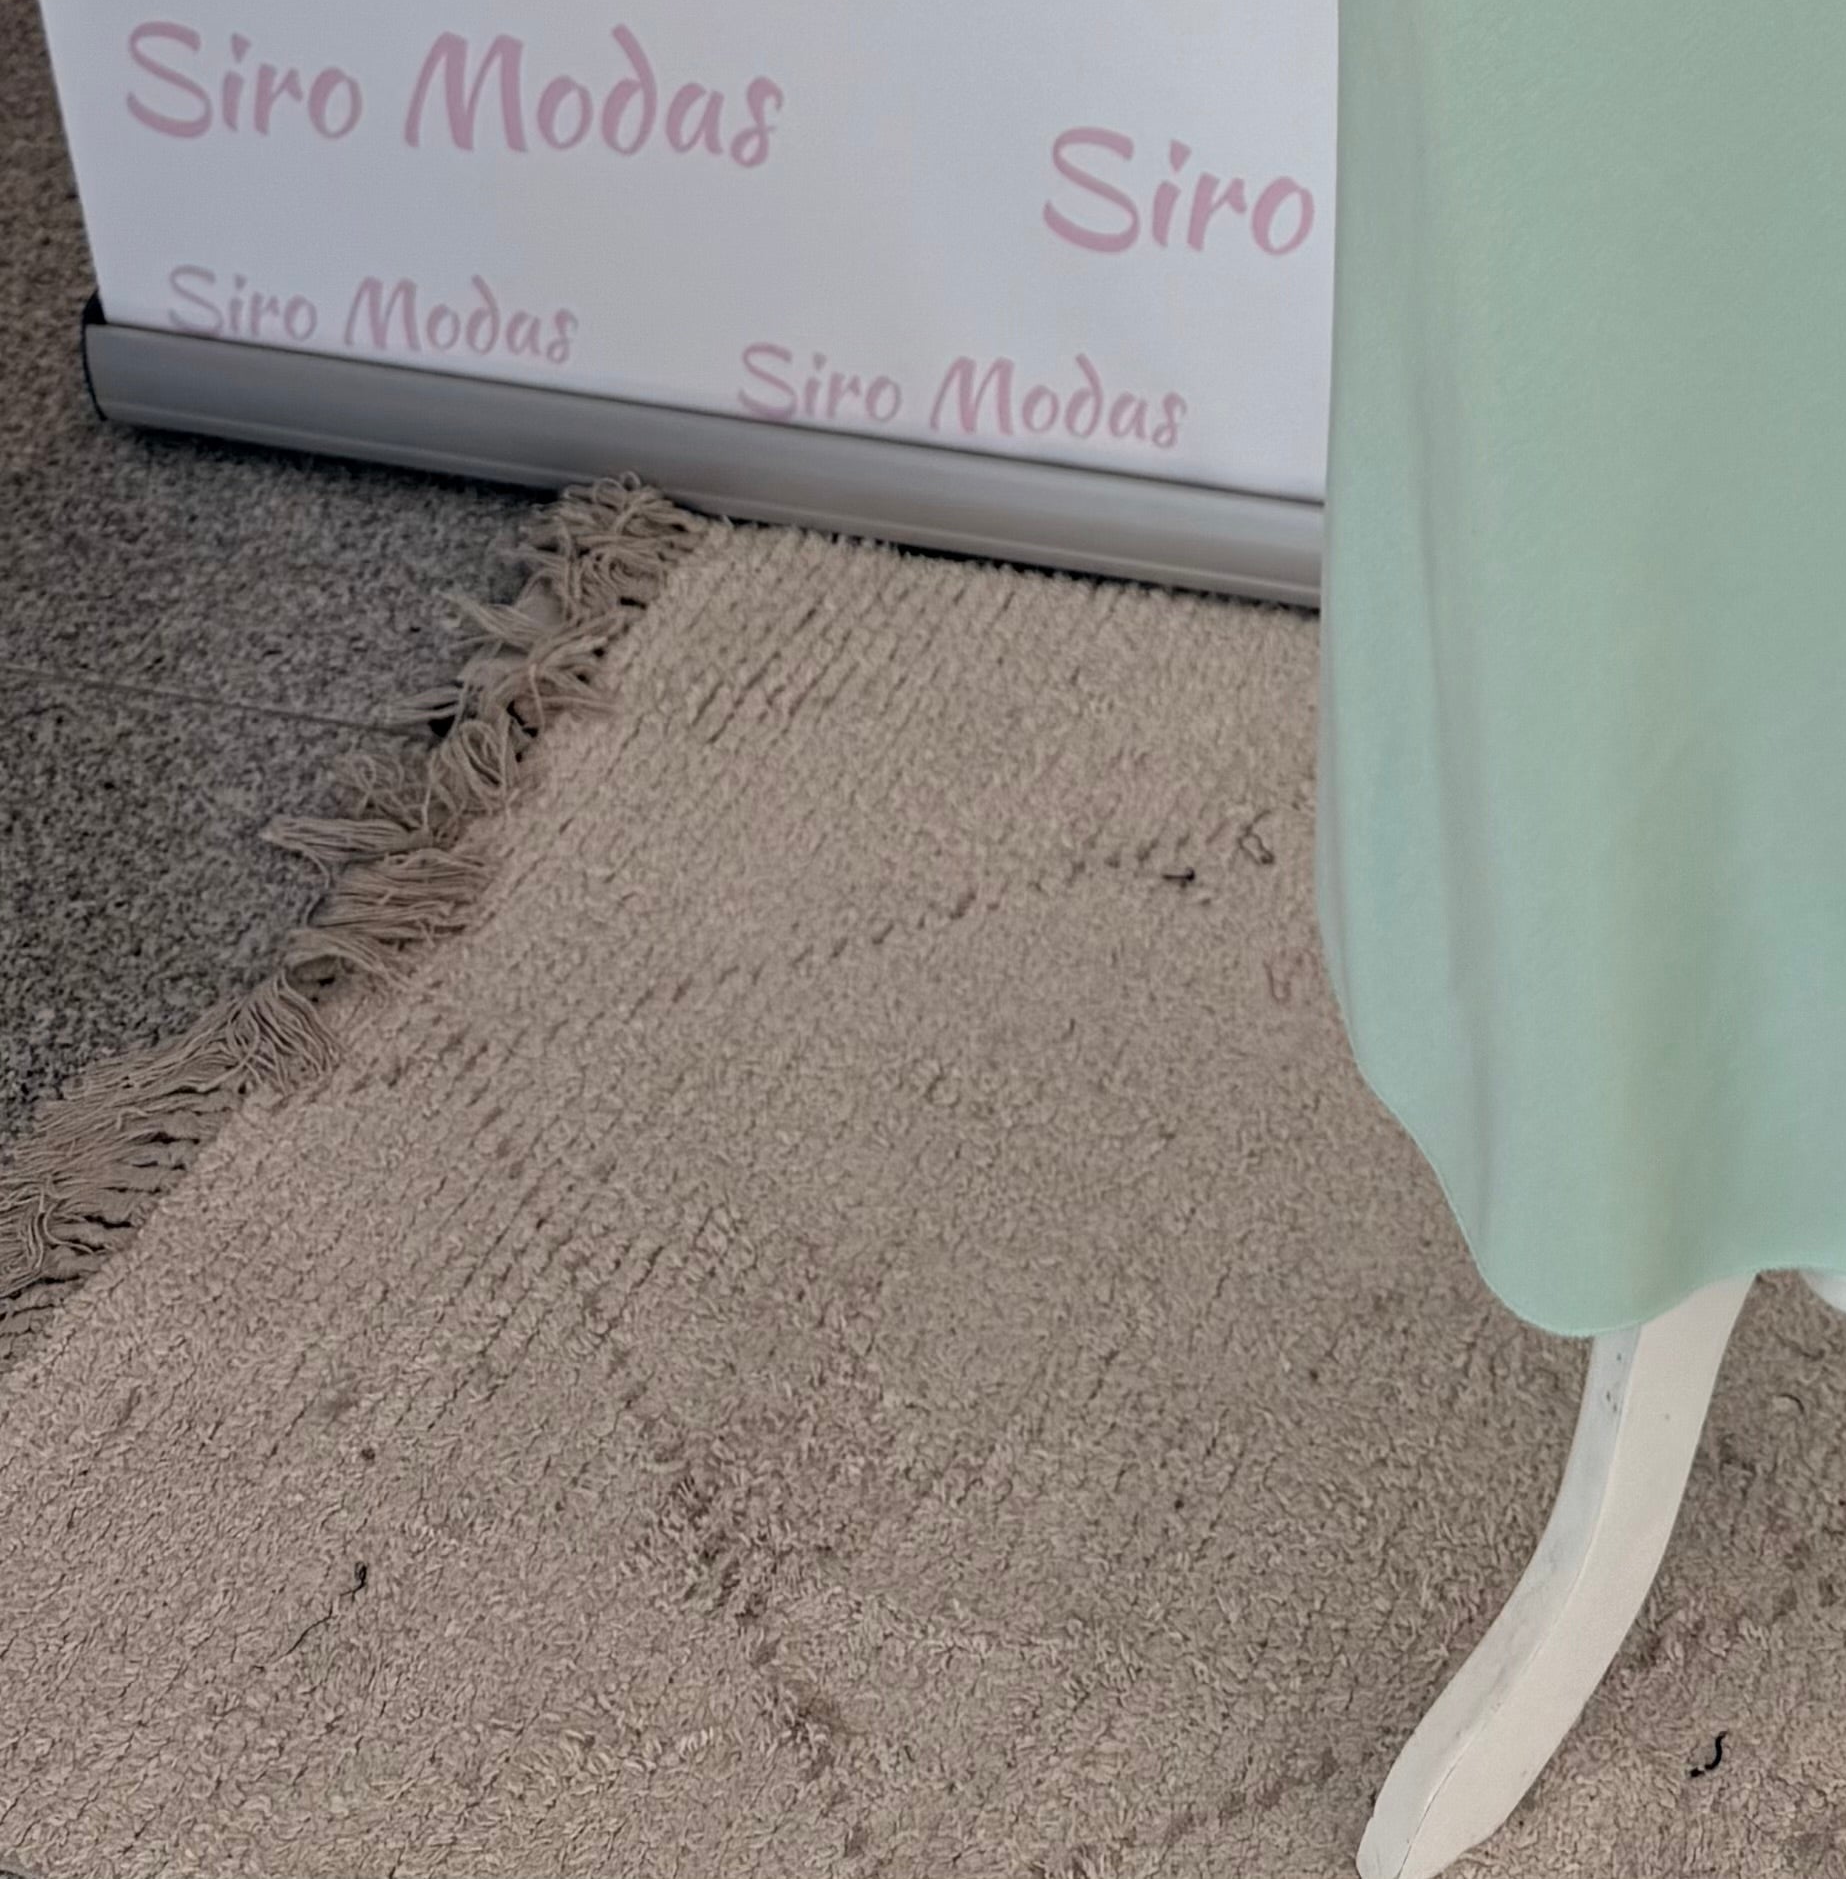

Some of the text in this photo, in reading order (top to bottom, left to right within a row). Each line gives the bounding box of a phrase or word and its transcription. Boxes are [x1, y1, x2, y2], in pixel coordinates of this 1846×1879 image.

[128, 20, 780, 166] Siro Modas
[1042, 127, 1315, 256] Siro
[168, 265, 578, 364] Siro Modas
[737, 343, 1188, 449] Siro Modas
